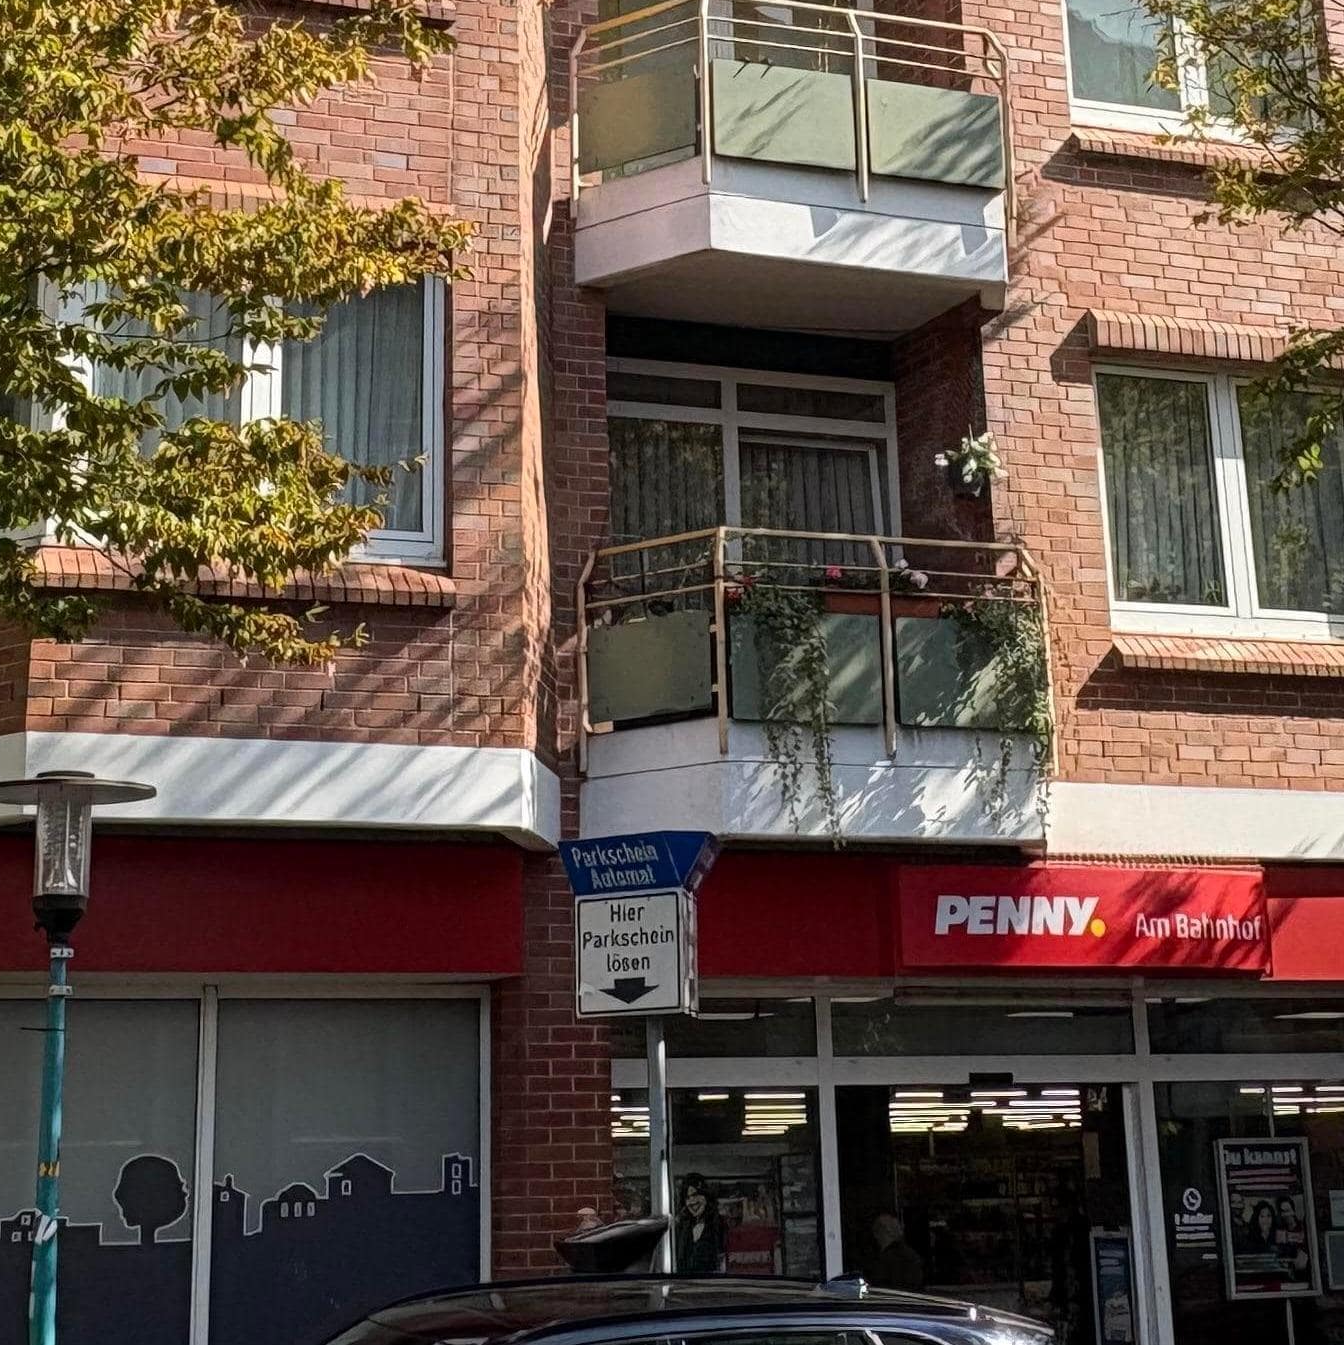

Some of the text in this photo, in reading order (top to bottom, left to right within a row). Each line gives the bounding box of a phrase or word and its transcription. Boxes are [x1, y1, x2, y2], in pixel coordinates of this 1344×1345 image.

[570, 840, 659, 869] Parkschein
[590, 864, 657, 890] Automat
[610, 903, 646, 923] Hier
[582, 924, 674, 950] Parkschein
[1135, 912, 1262, 941] Am Bahnhof
